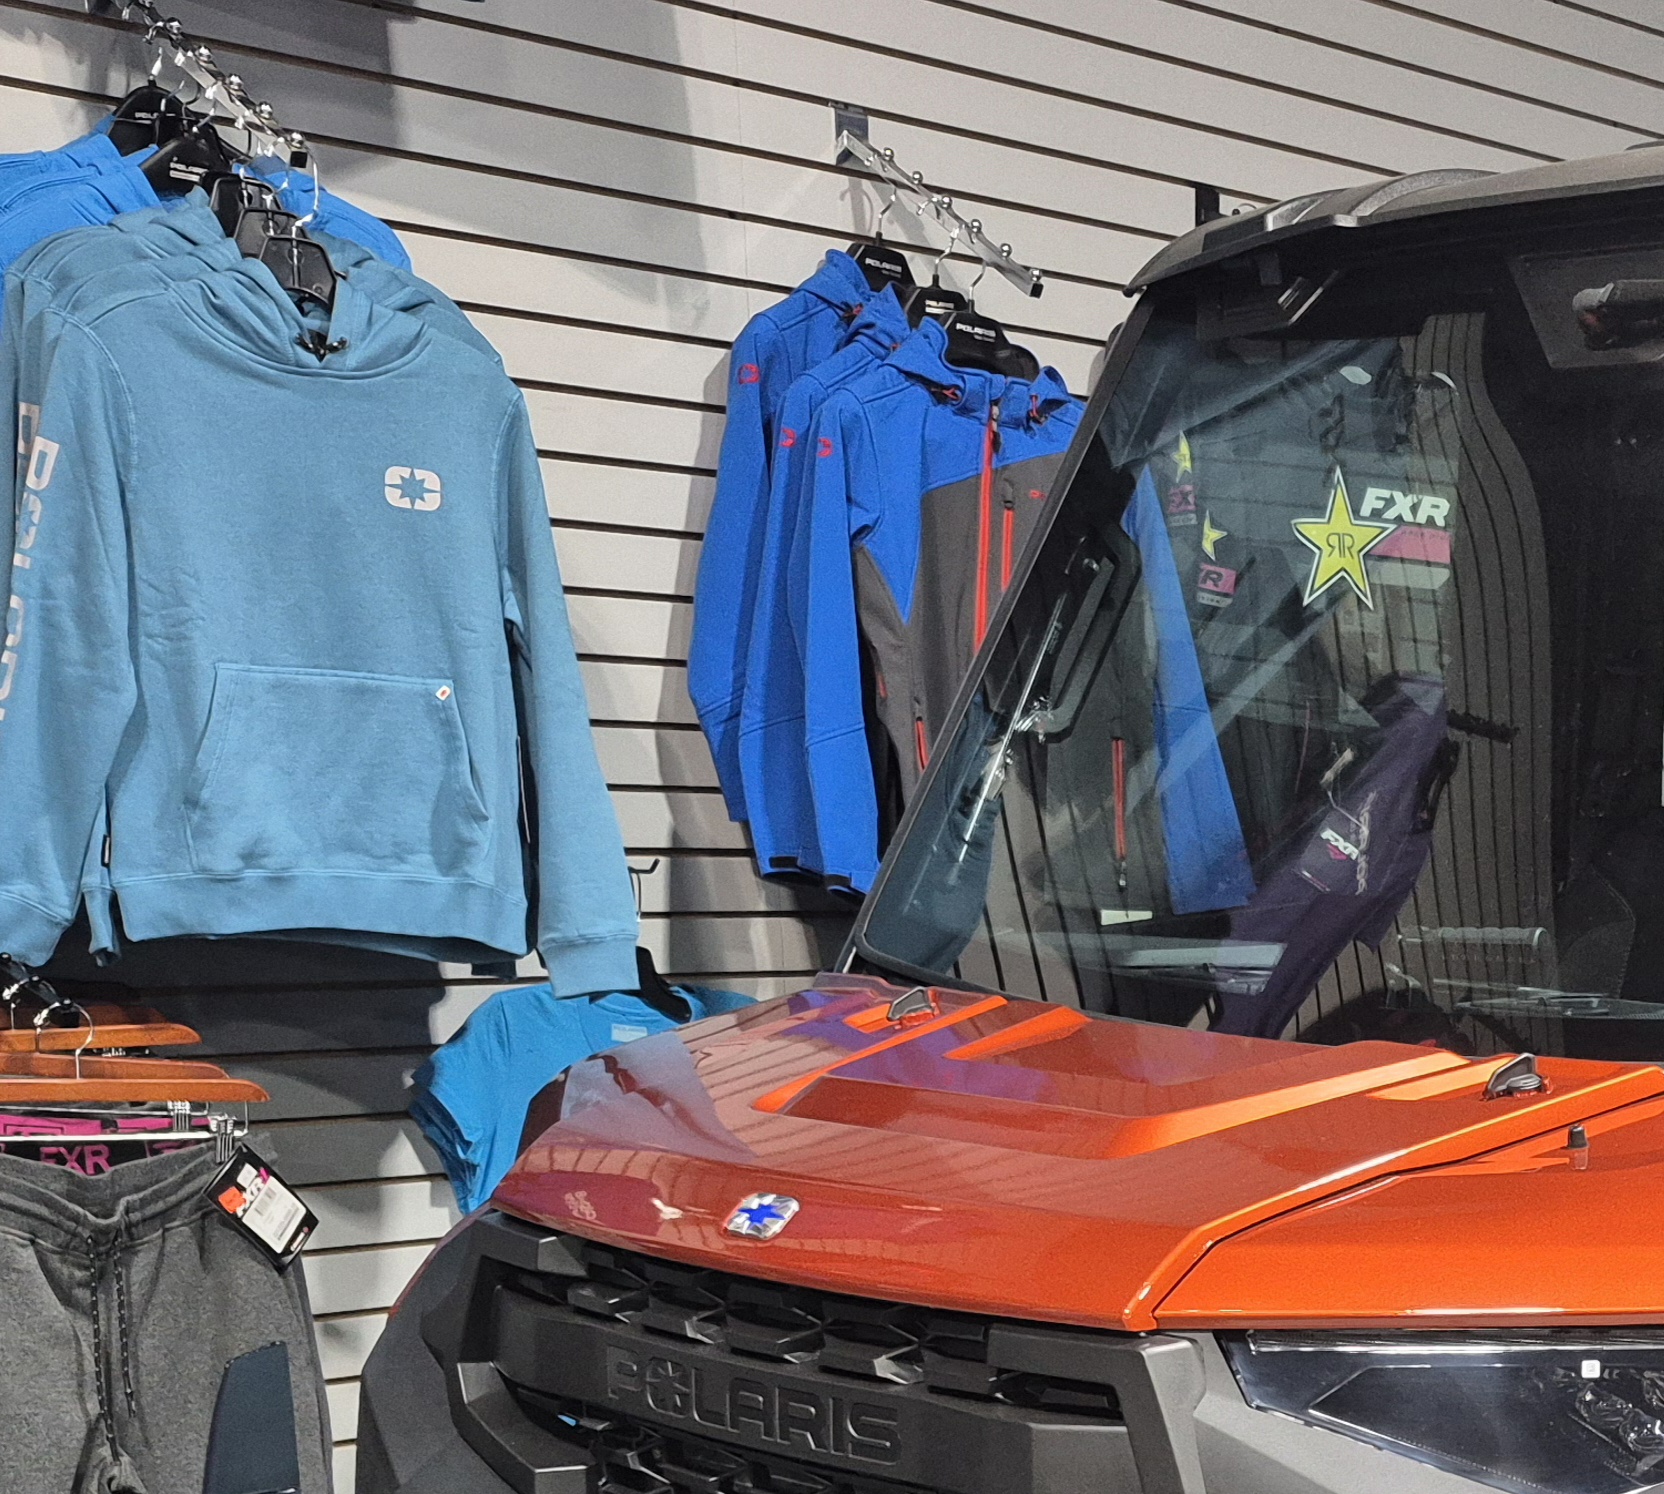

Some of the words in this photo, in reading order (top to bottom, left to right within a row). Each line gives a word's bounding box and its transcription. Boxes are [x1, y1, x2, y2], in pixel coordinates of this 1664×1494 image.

[1359, 486, 1451, 528] FXR
[1320, 827, 1360, 861] FXR
[39, 1144, 113, 1177] FXR
[607, 1344, 902, 1466] POLARIS
